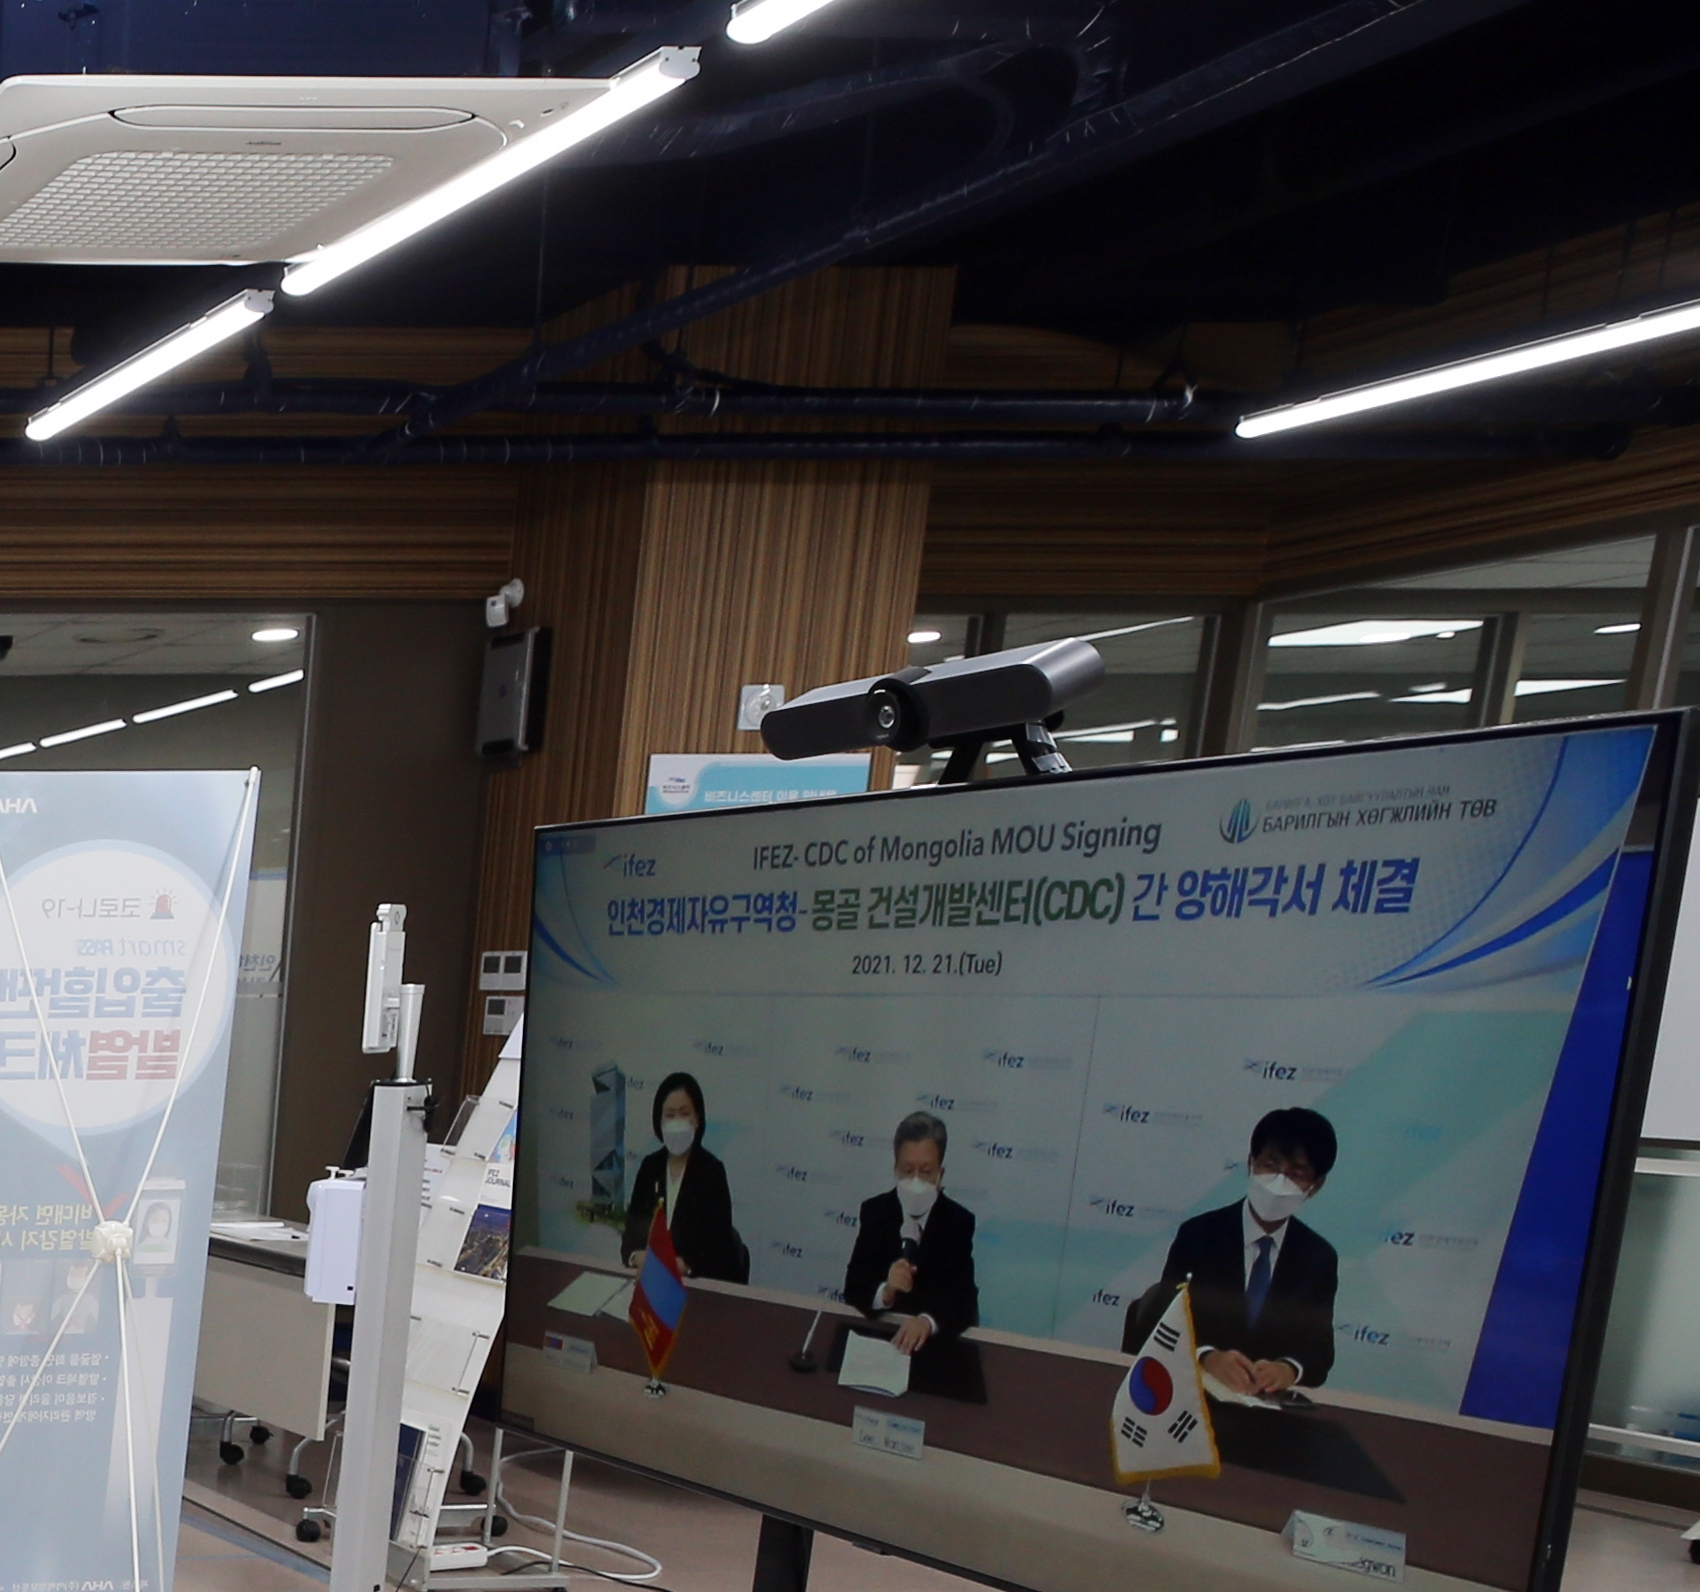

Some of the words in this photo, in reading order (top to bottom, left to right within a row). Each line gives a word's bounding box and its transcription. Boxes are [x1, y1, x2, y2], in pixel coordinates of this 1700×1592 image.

[1460, 798, 1498, 822] ТӨВ
[804, 839, 848, 868] CDC
[853, 836, 876, 864] of
[880, 829, 985, 868] Mongolia
[991, 824, 1055, 855] MOU
[1061, 817, 1162, 857] Signing
[622, 854, 656, 878] ifez
[867, 872, 1125, 930] 건설개발센터(CDC)
[1132, 872, 1169, 923] 간
[1174, 862, 1327, 921] 양해각서
[1331, 857, 1420, 916] 체결
